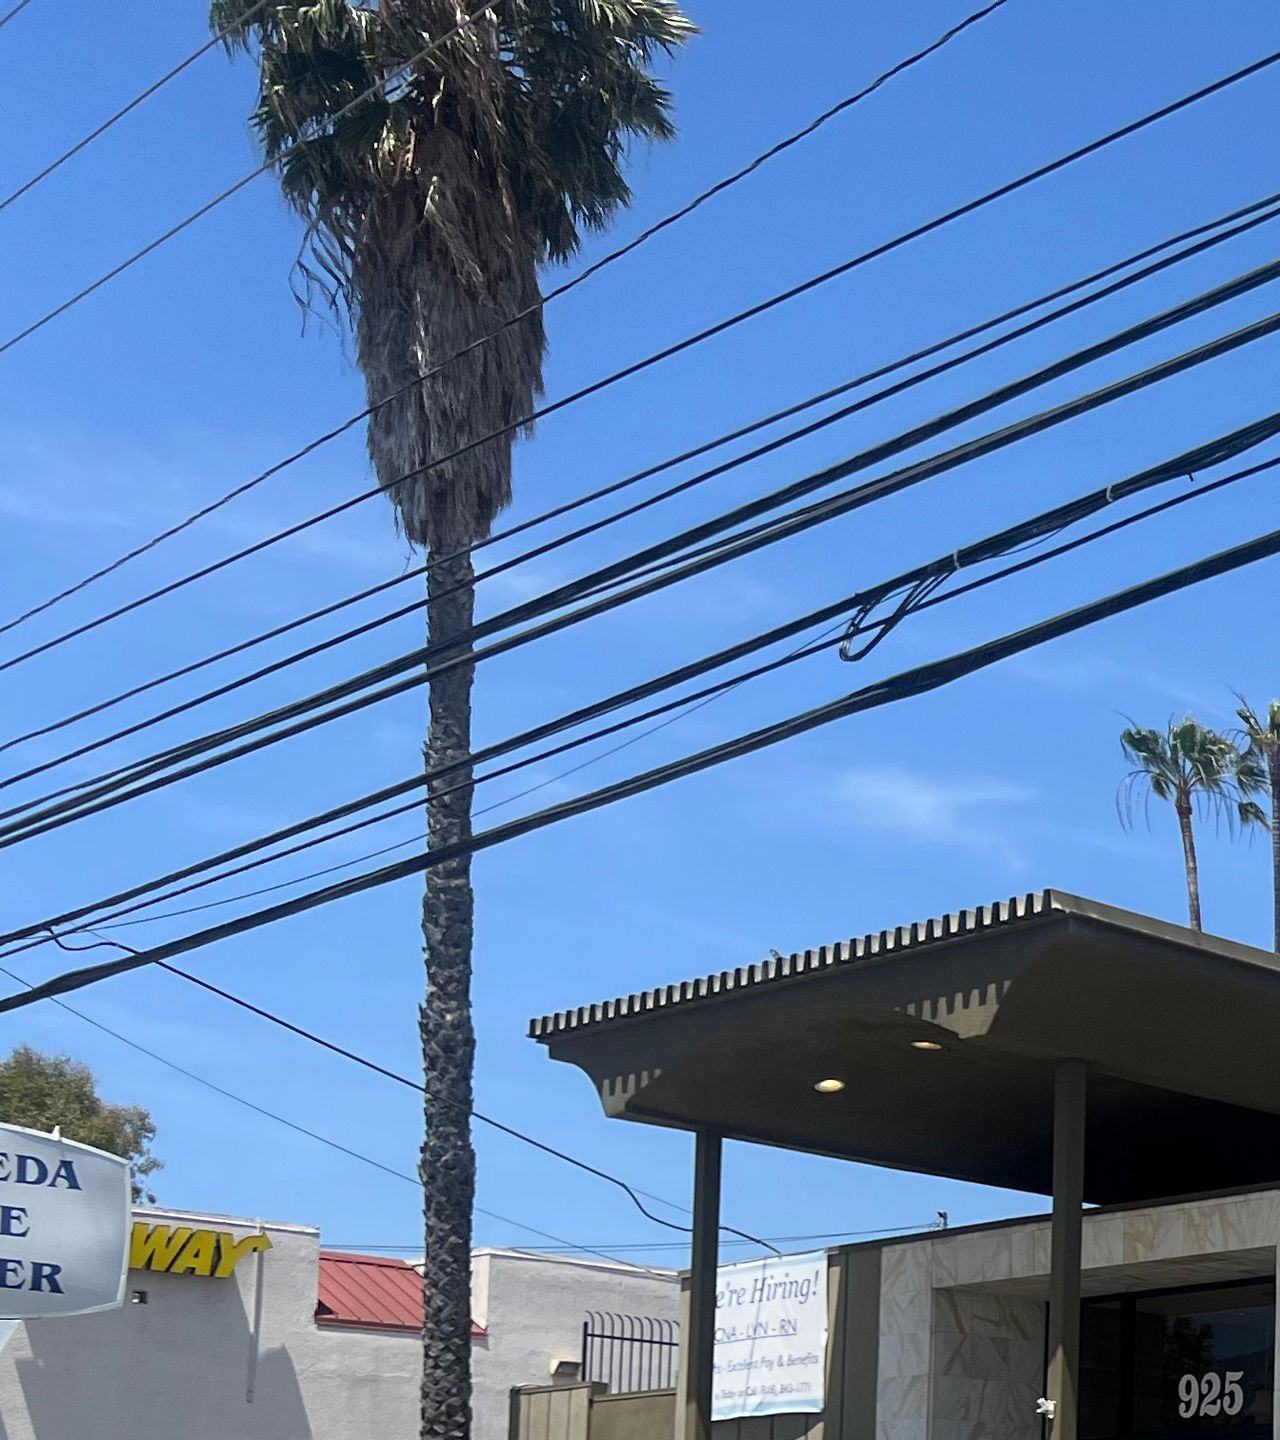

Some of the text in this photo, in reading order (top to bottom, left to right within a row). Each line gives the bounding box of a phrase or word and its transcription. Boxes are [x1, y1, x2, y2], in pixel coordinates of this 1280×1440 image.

[129, 1222, 273, 1278] WAY
[750, 1270, 819, 1304] Hiring!
[1178, 1371, 1244, 1418] 925
